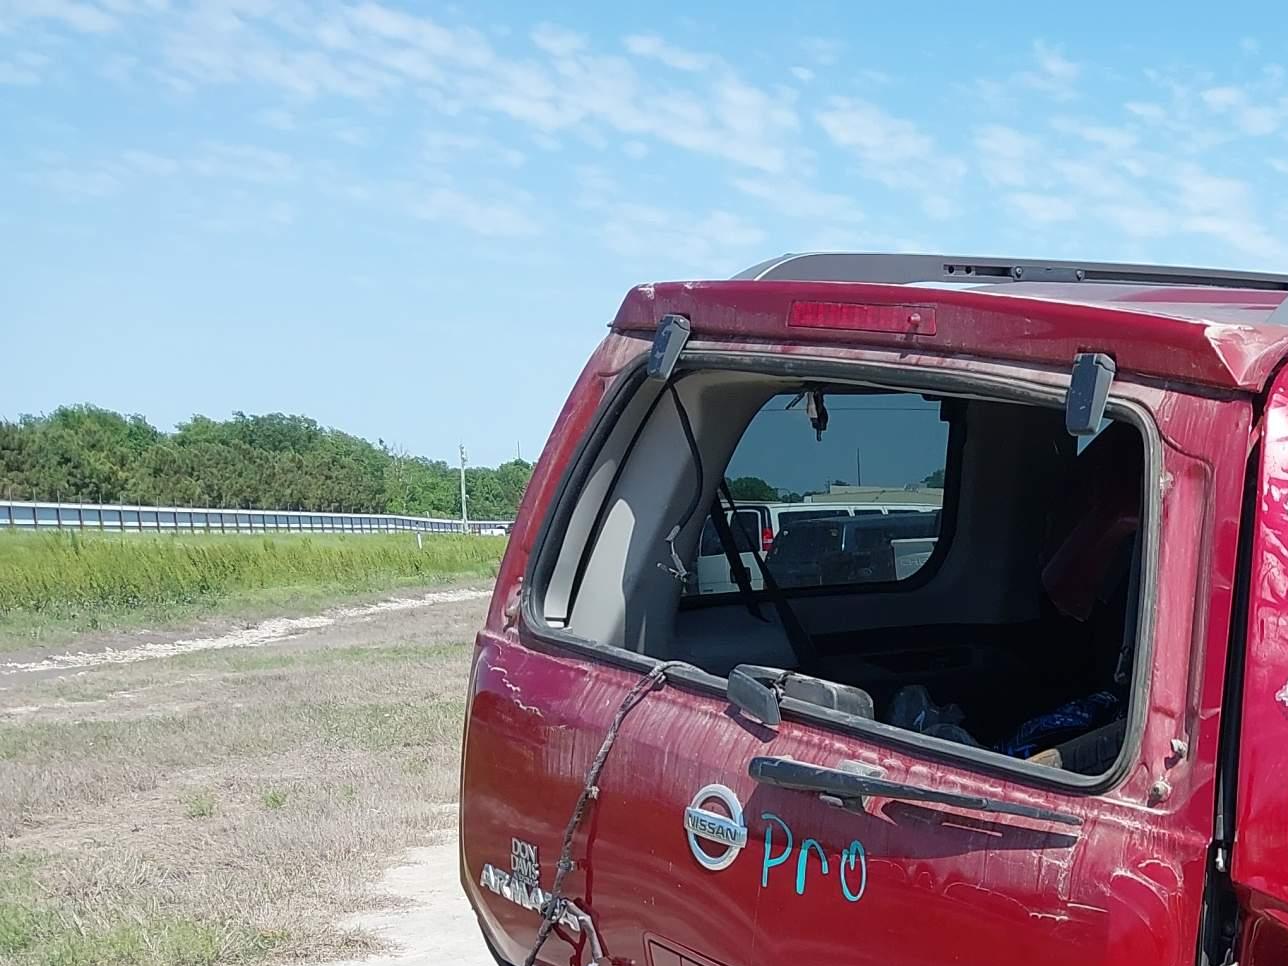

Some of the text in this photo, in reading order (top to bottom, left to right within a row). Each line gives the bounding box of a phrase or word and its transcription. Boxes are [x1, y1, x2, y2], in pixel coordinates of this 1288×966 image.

[687, 812, 738, 842] NISSAN
[511, 837, 538, 865] DON
[510, 853, 539, 880] DAVIS
